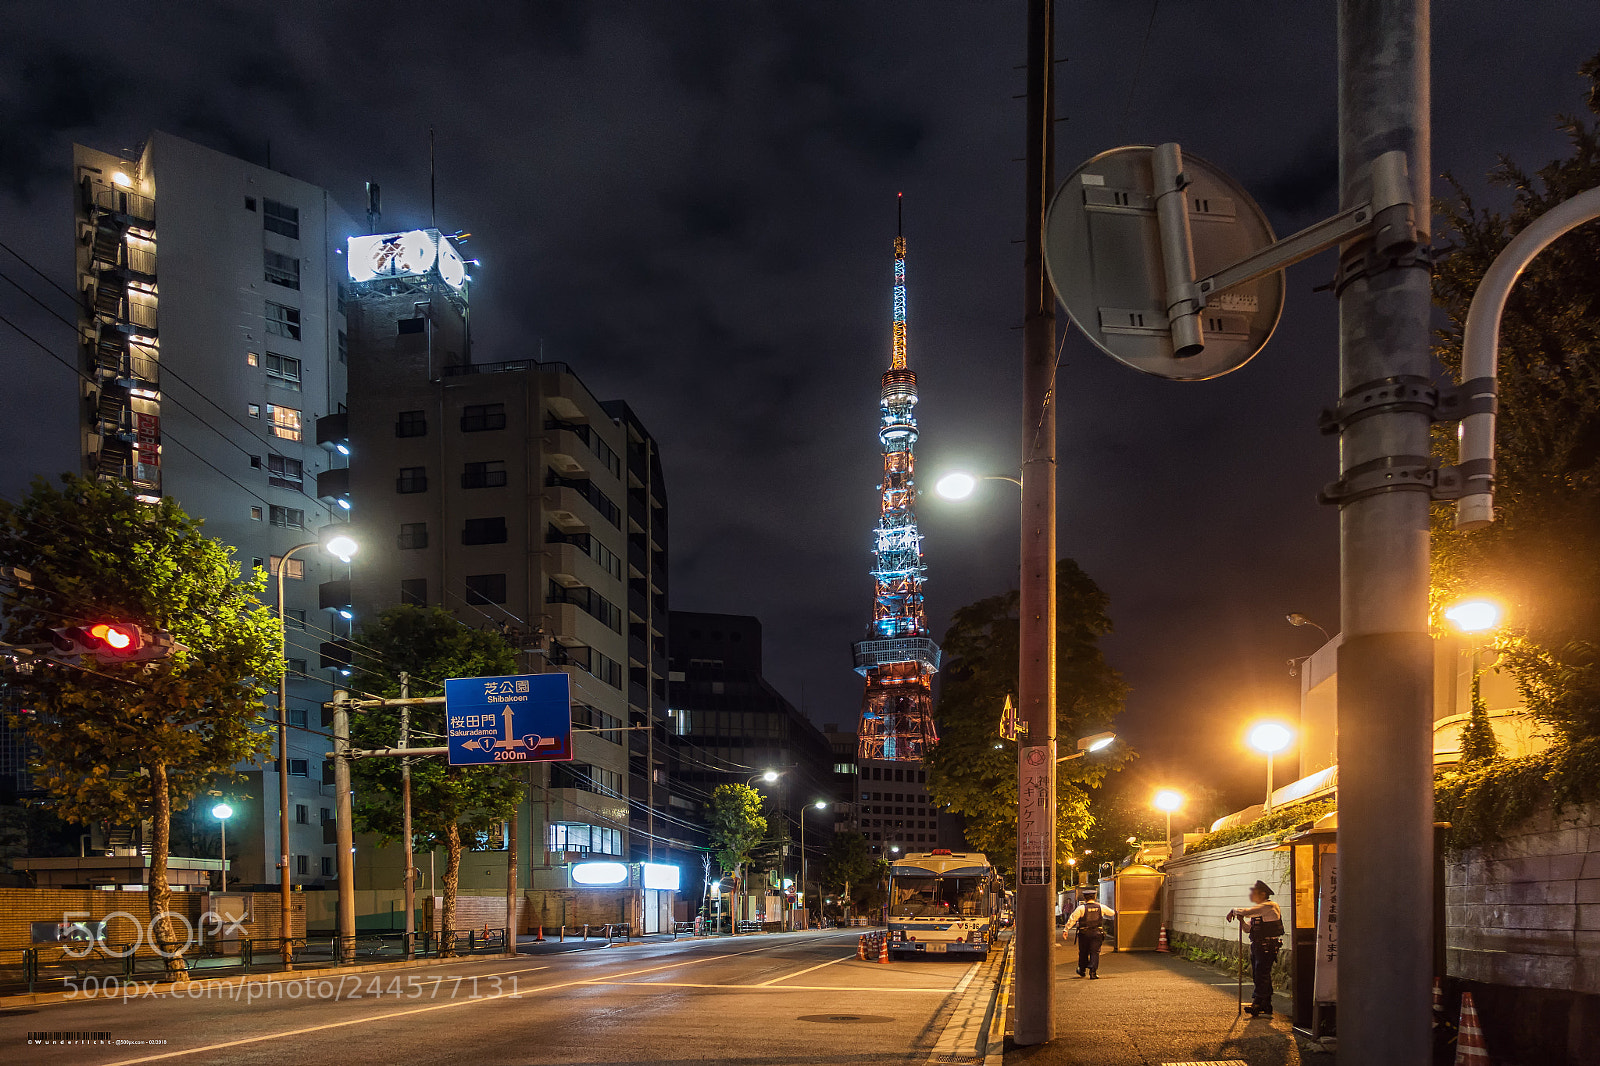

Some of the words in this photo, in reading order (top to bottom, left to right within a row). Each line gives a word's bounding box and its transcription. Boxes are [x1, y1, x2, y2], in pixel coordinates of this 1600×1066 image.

[484, 680, 529, 695] 芝公園
[487, 695, 528, 703] Shibakoen
[450, 714, 496, 728] 桜田門
[449, 729, 498, 737] Sakuradamon
[494, 751, 527, 760] 200m
[1023, 776, 1034, 830] スキンケア
